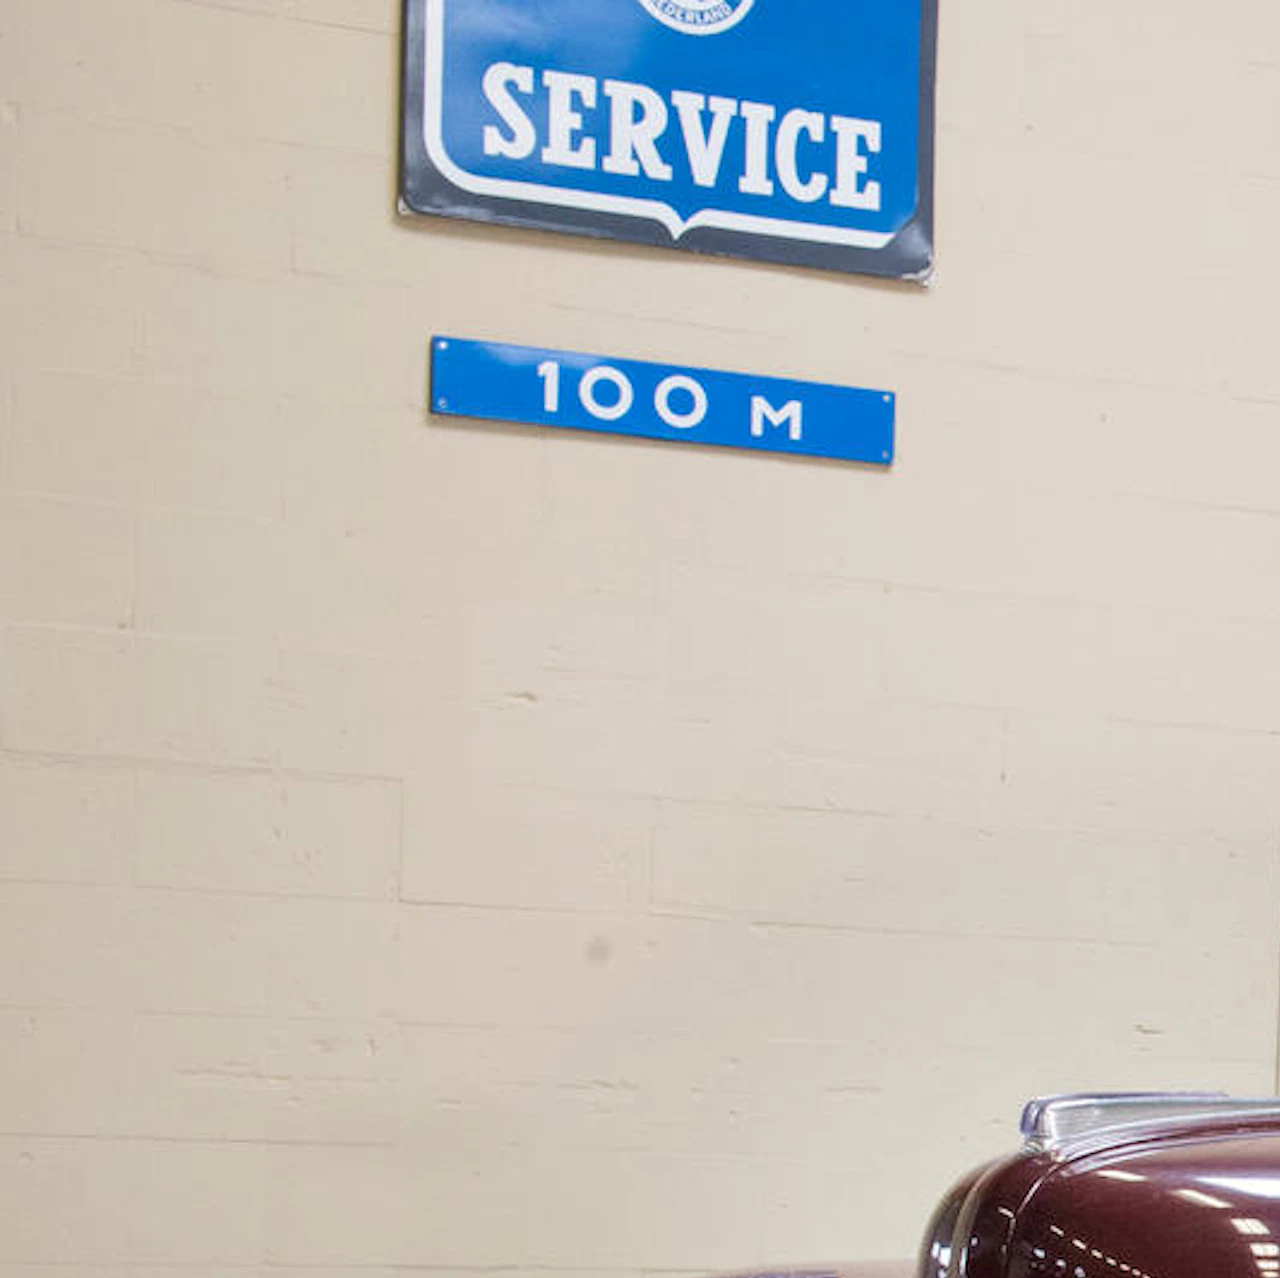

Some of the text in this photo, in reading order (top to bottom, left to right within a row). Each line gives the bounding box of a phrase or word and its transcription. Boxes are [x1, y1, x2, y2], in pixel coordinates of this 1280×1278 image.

[482, 62, 882, 211] SERVICE
[537, 361, 802, 441] 100 M
